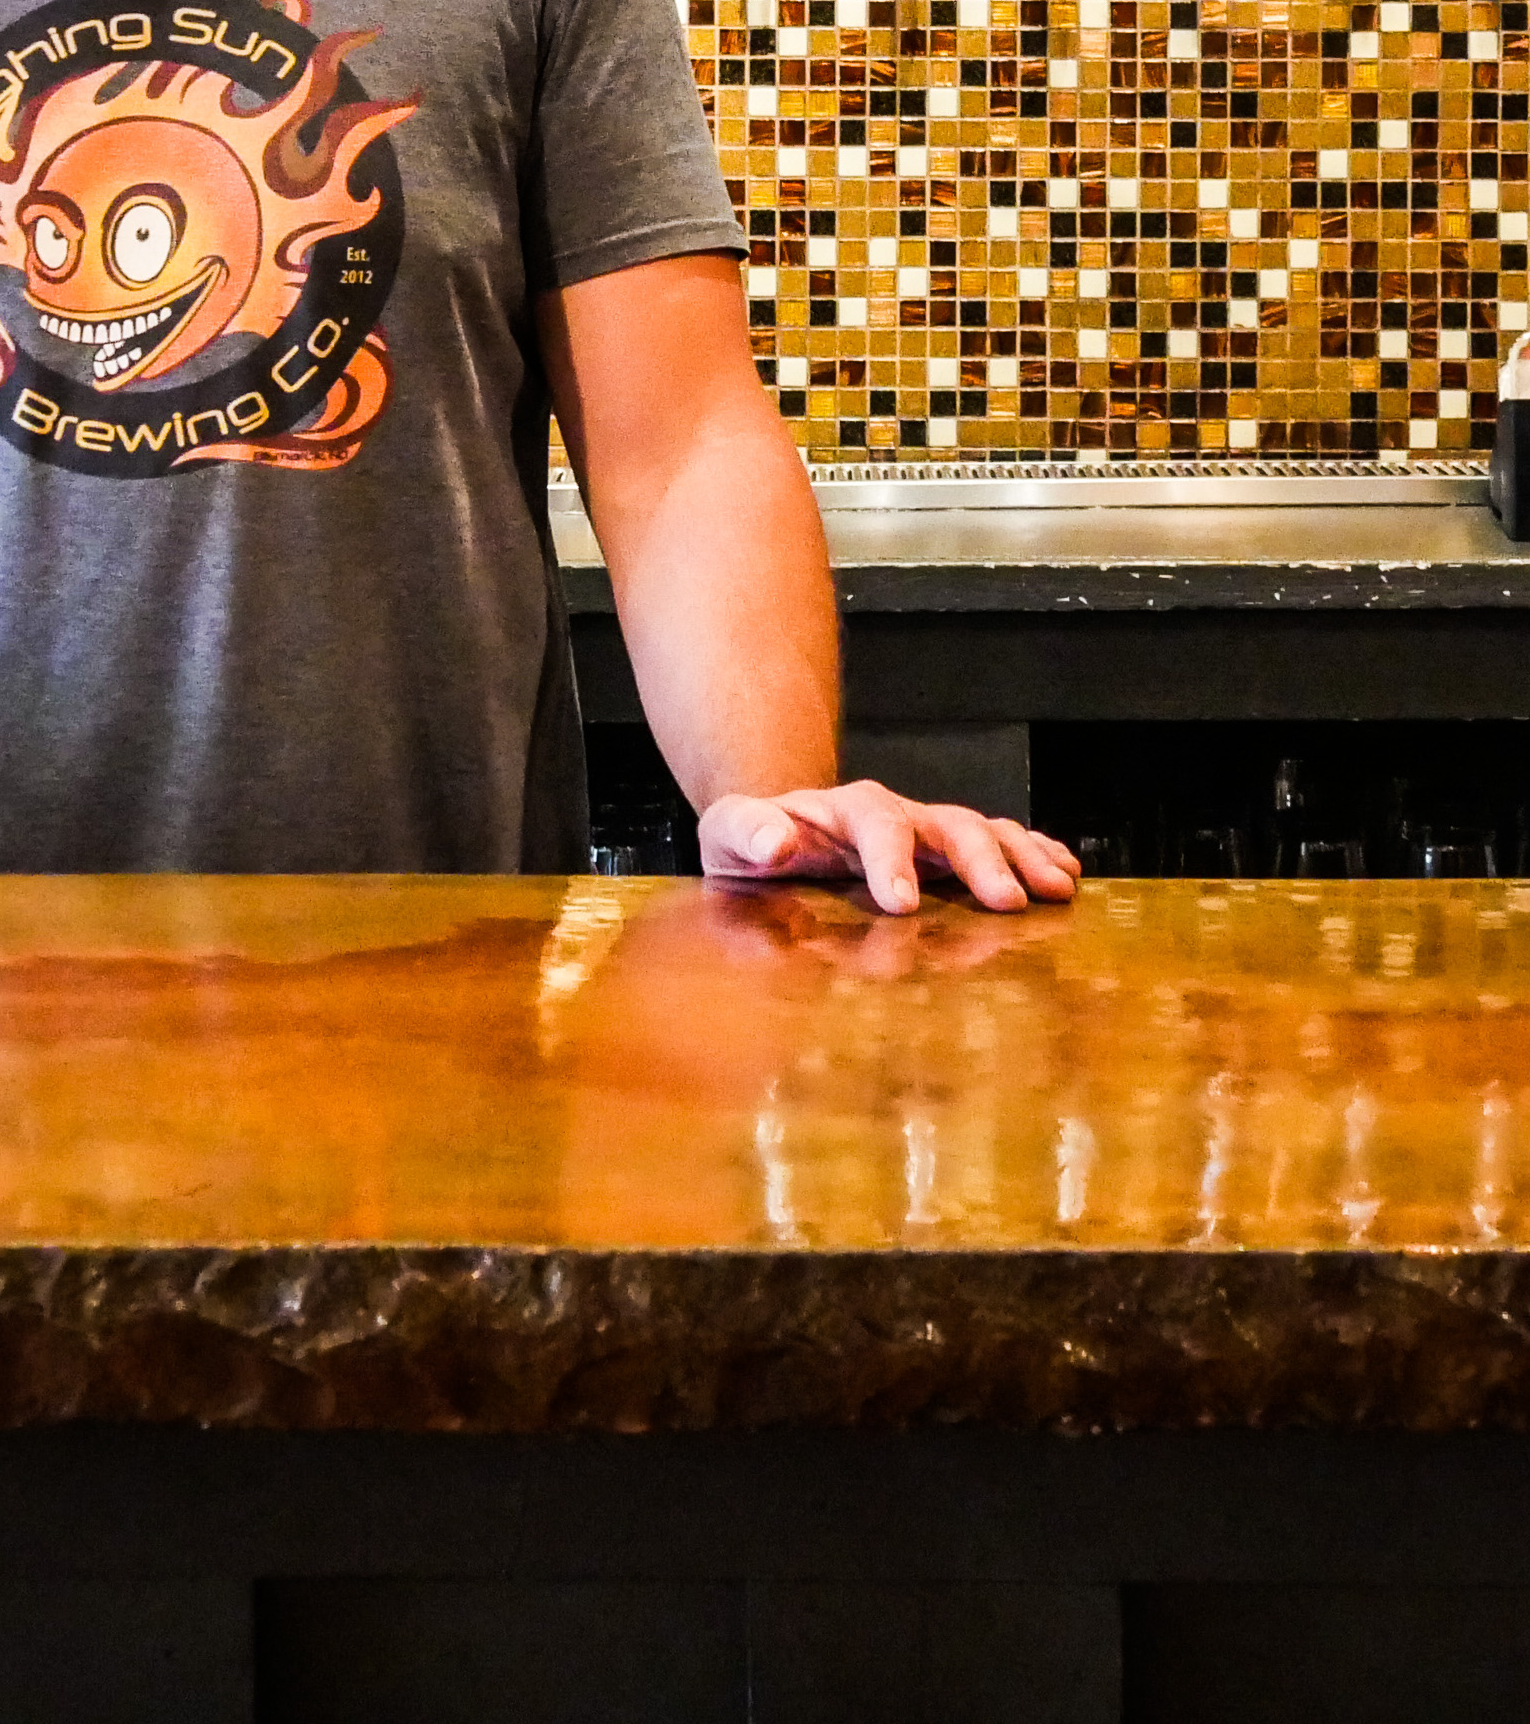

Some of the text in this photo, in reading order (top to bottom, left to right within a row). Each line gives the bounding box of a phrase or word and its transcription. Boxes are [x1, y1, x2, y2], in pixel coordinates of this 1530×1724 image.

[170, 7, 298, 80] Sun
[346, 246, 370, 262] Est.
[340, 269, 373, 285] 2012
[12, 315, 351, 453] Brewing Co.
